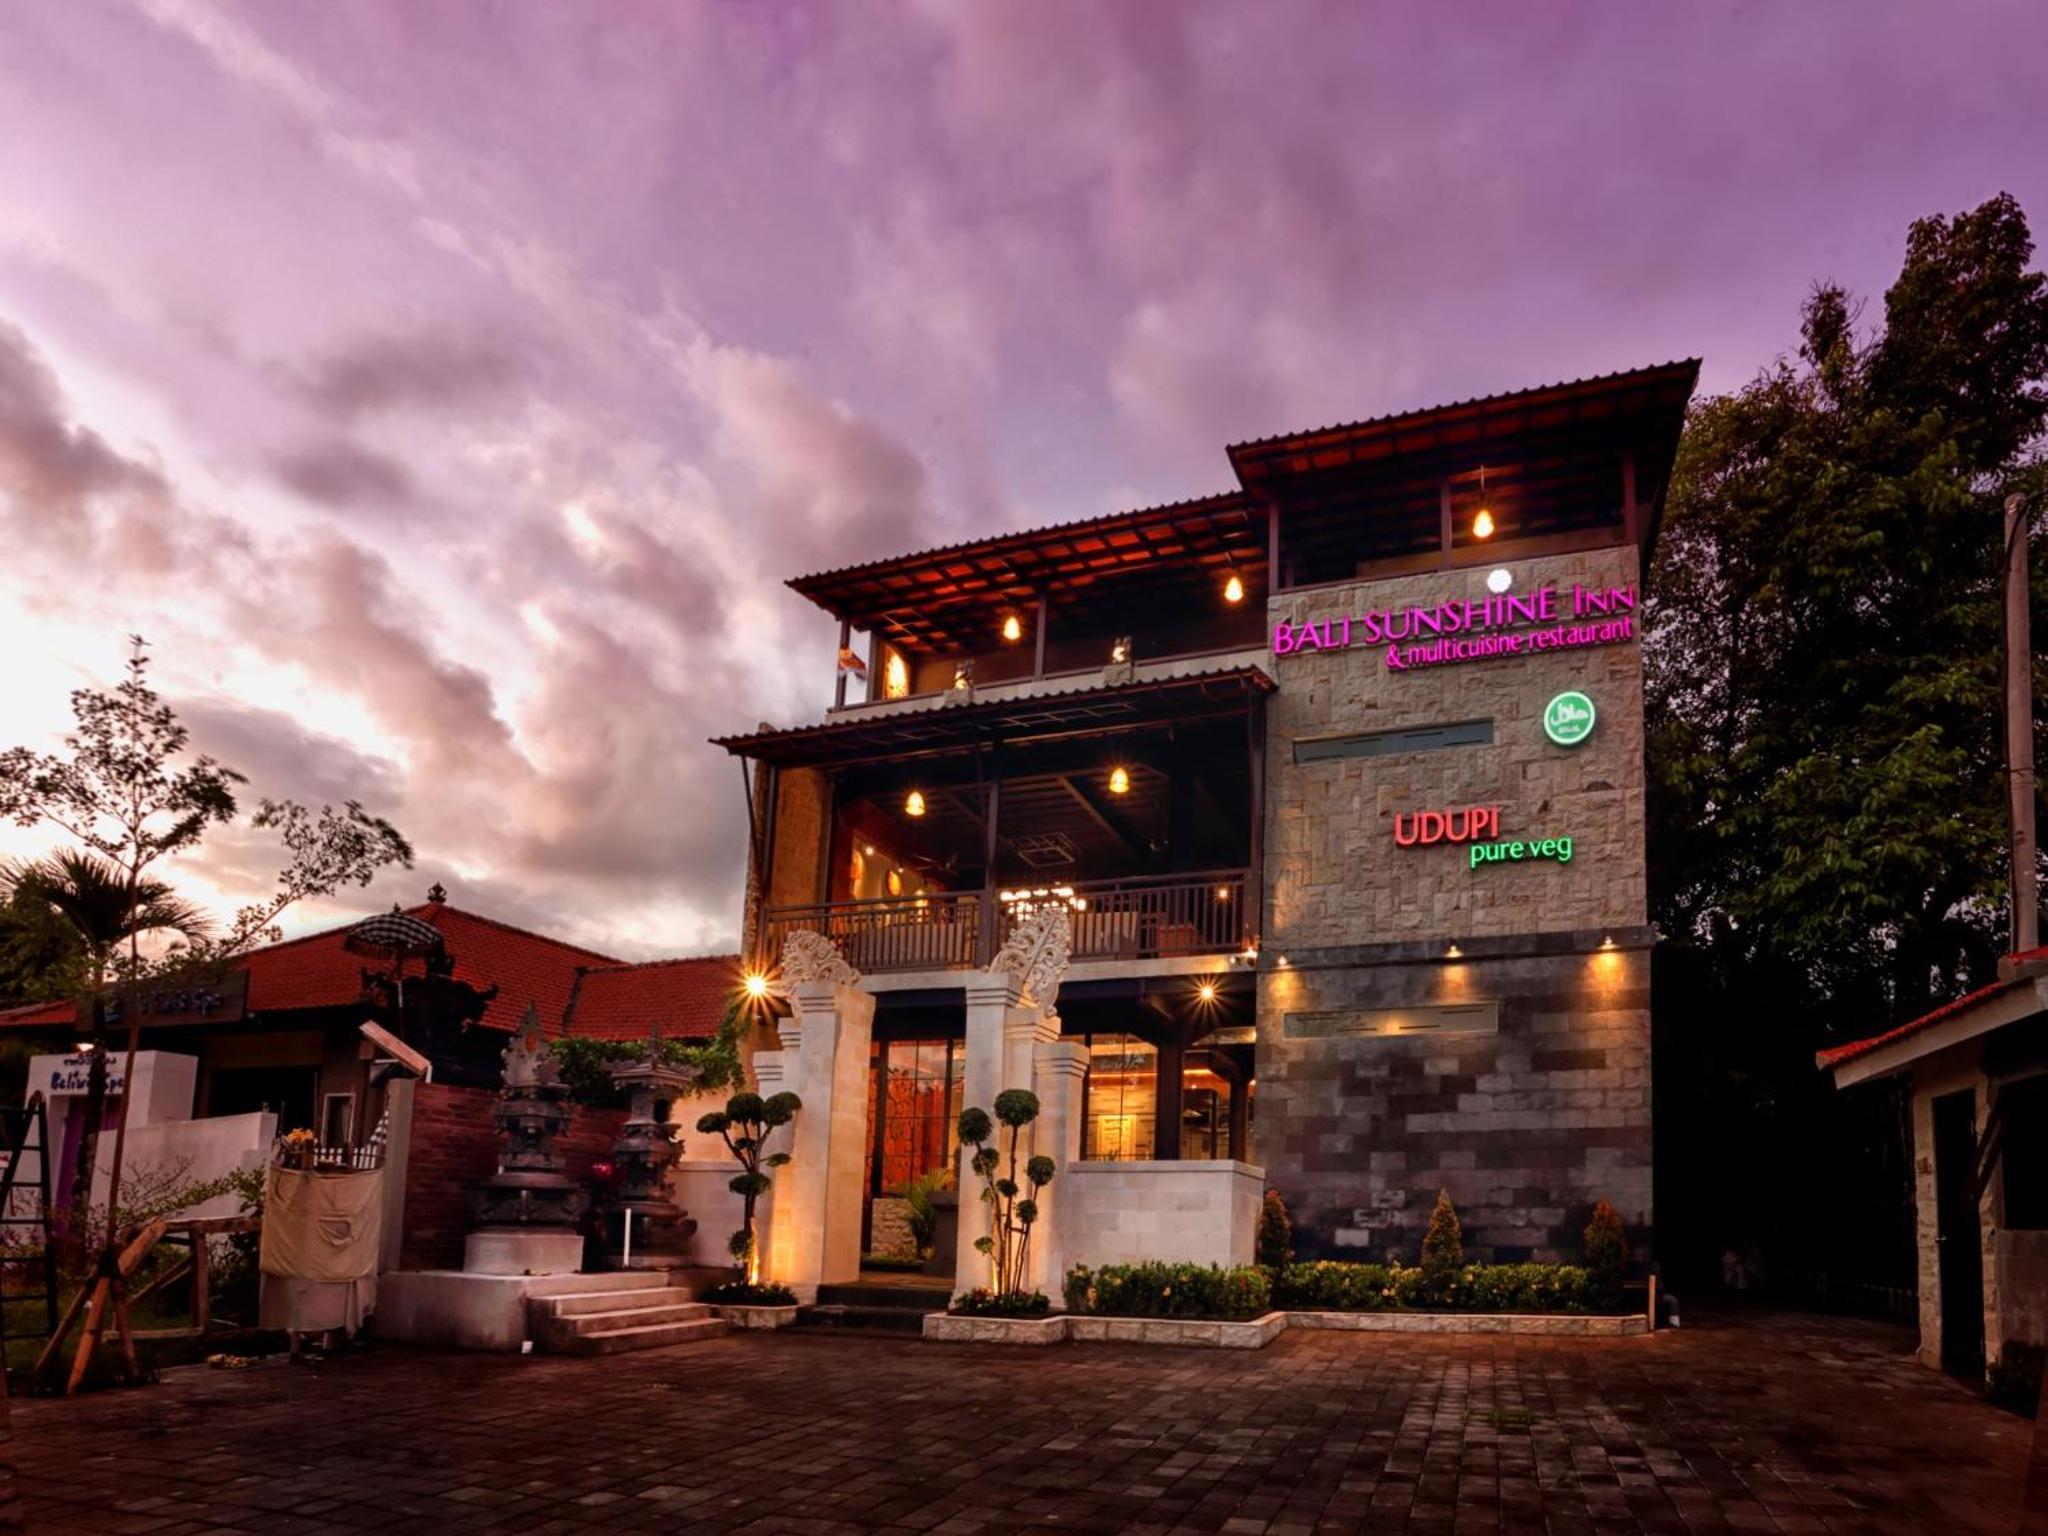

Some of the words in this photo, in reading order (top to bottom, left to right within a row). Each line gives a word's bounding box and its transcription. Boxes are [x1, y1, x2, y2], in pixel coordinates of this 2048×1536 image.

[1274, 613, 1351, 655] BALI
[1364, 586, 1557, 644] SUNSHINE
[1386, 643, 1408, 669] &
[1408, 631, 1522, 665] multicuisine
[1528, 616, 1633, 650] restaurant
[1395, 806, 1500, 847] UDUPI
[1470, 841, 1524, 869] pure
[1529, 835, 1573, 862] veg
